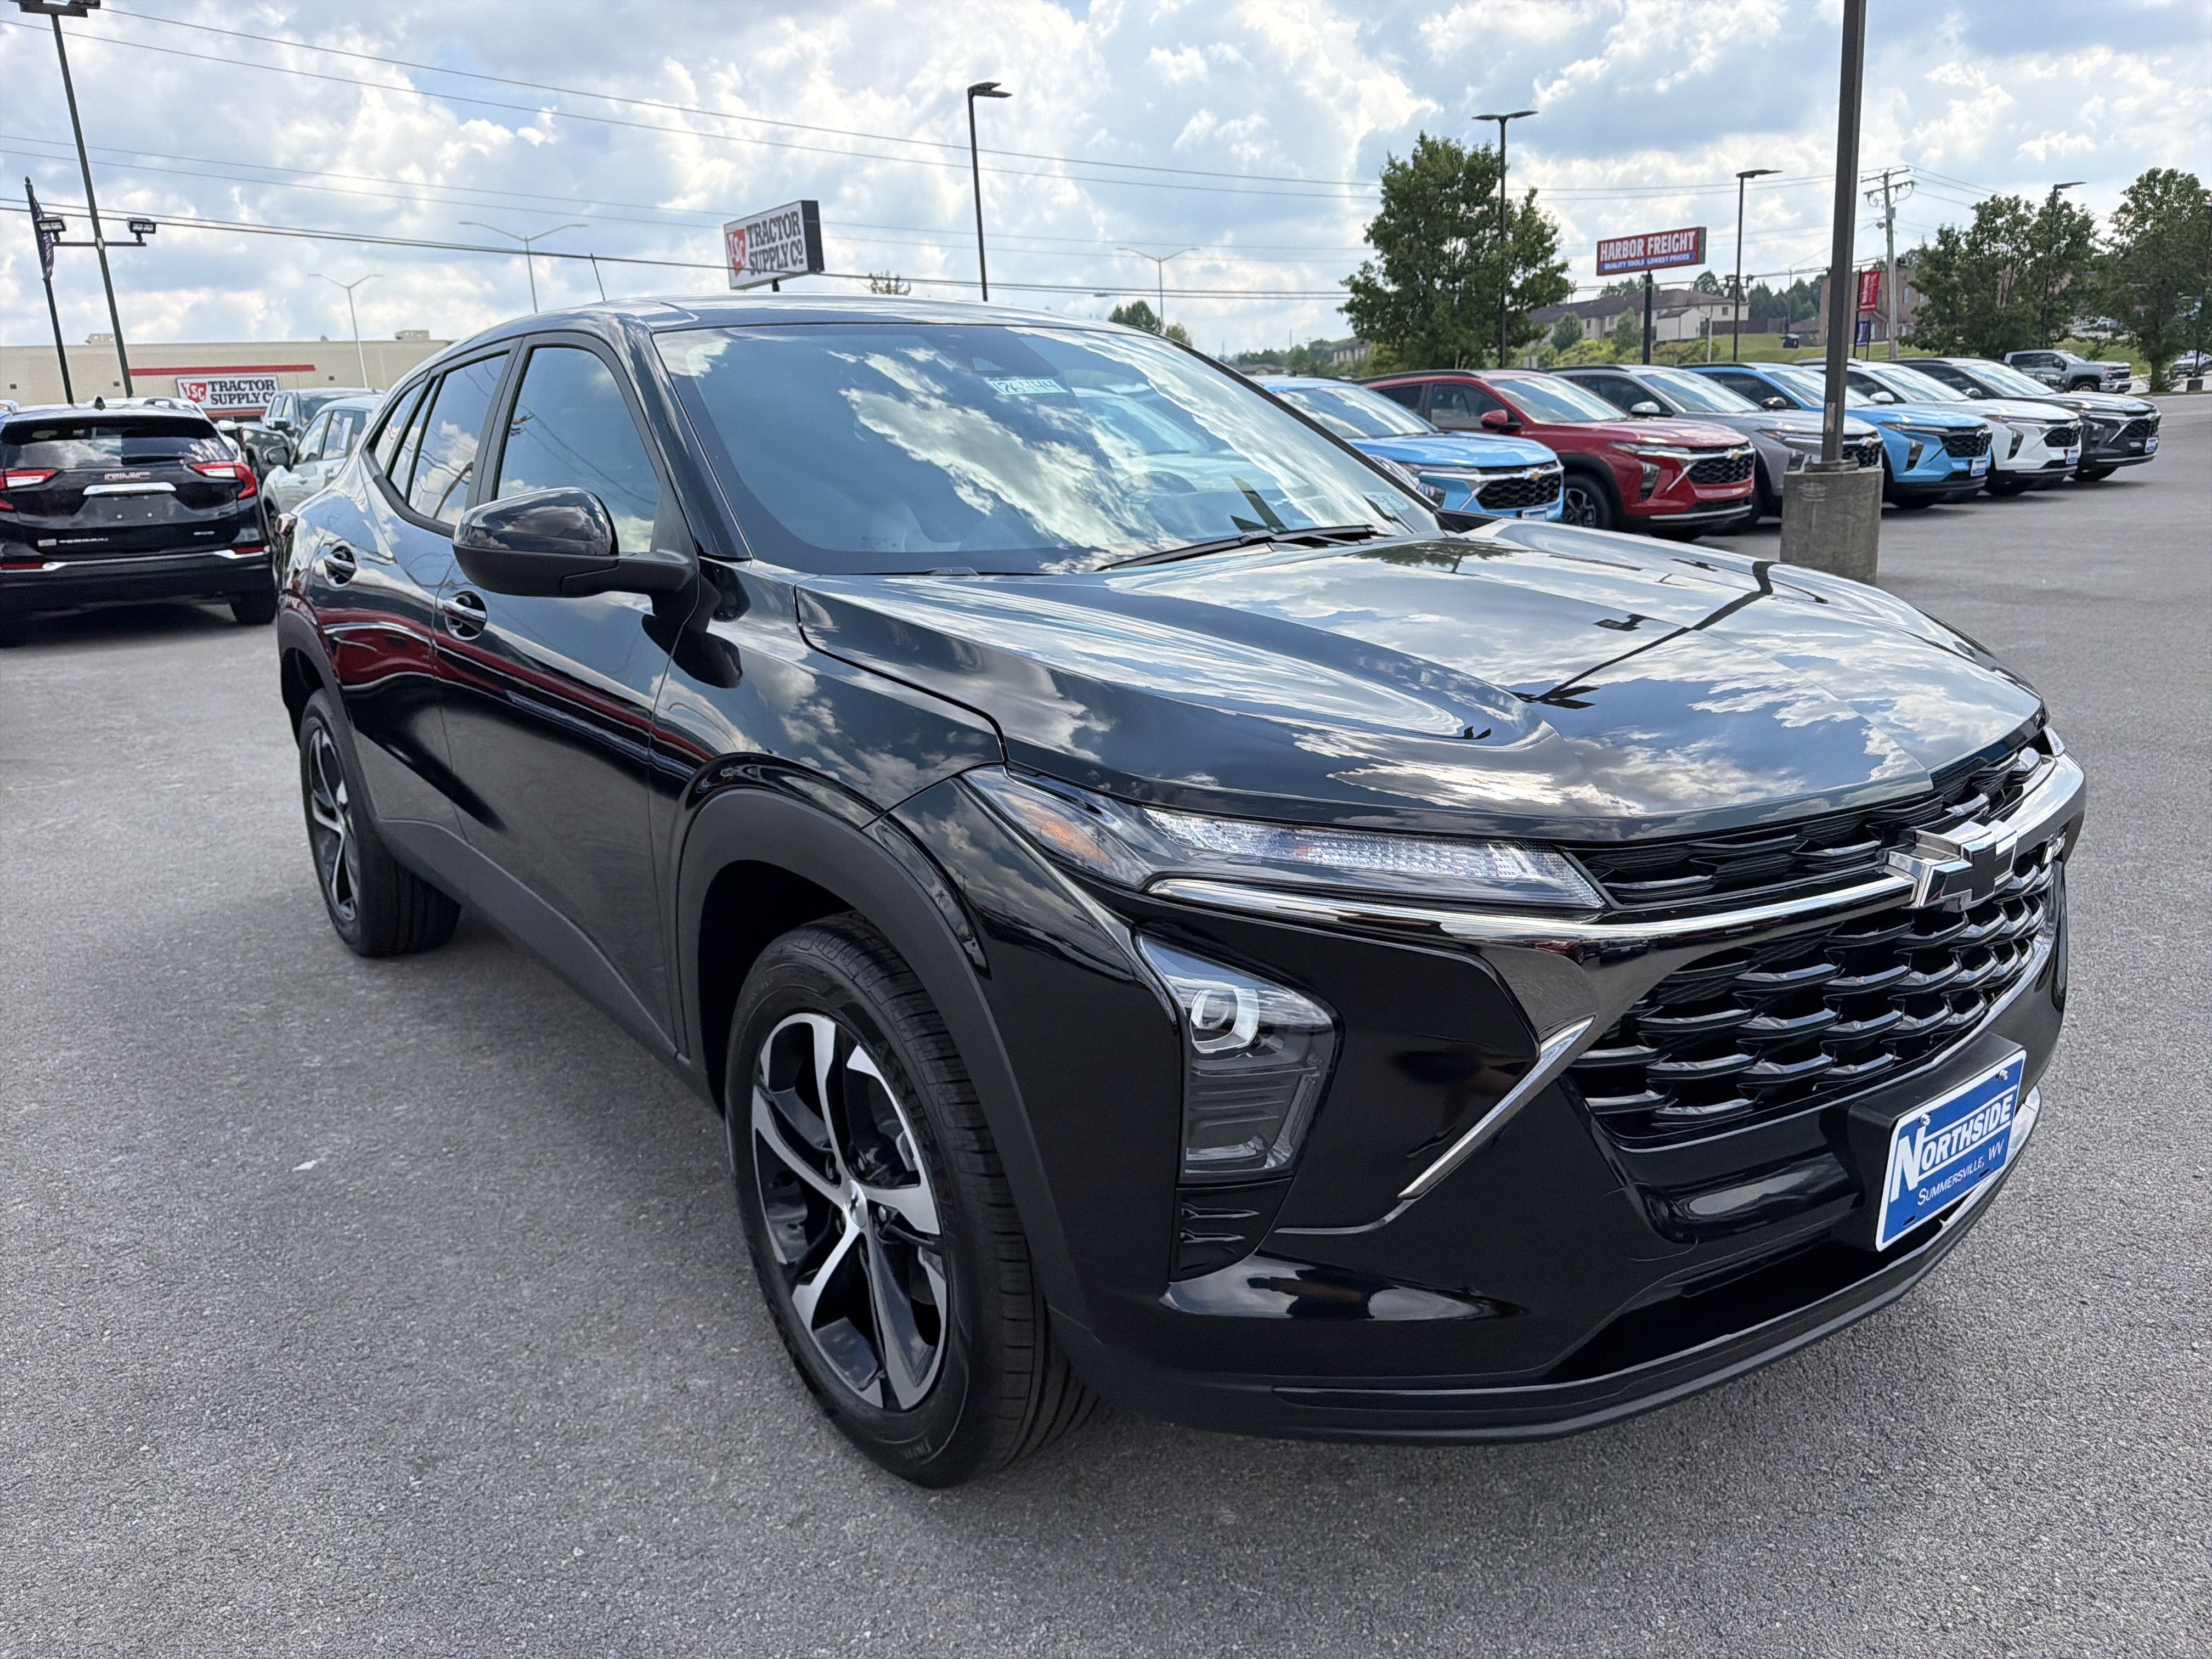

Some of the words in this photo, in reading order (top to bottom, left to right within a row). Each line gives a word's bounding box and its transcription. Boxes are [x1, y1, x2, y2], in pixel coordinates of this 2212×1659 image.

[746, 211, 801, 249] TRACTOR
[1600, 238, 1645, 262] HARBOR
[1647, 230, 1696, 256] FREIGHT
[727, 233, 746, 269] TSC
[749, 242, 789, 276] SUPPLY
[183, 383, 205, 400] TSC
[208, 380, 276, 392] TRACTOR
[210, 392, 261, 405] SUPPLY
[1890, 1094, 2013, 1203] NORTHSIDE
[1917, 1155, 1984, 1206] SUMMERSVILLE,
[1988, 1138, 2005, 1162] WV
